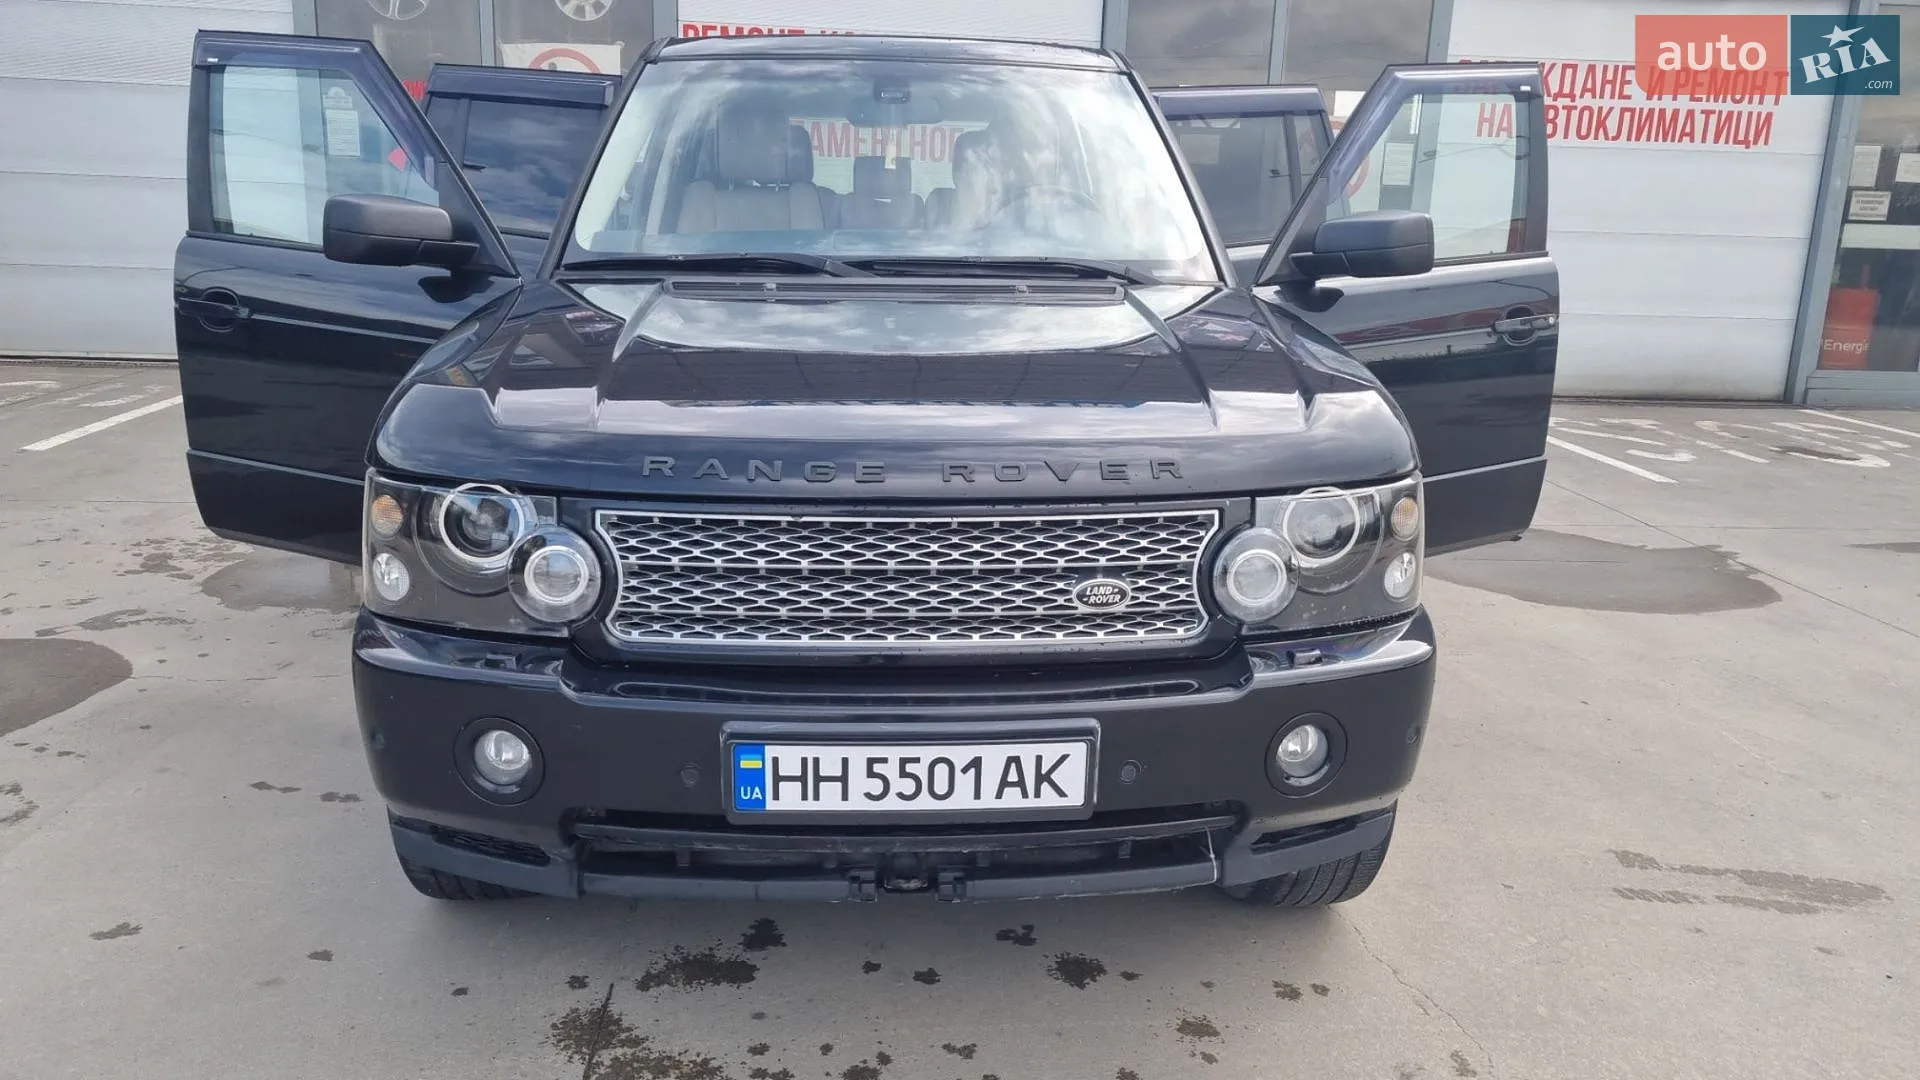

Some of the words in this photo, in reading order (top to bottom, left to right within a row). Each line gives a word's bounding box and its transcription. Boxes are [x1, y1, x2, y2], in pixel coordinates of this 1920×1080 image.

[1476, 102, 1513, 138] НА
[1544, 104, 1774, 149] ВТОКЛИМАТИЦИ
[642, 456, 887, 483] RANGE
[942, 457, 1184, 483] ROVER
[740, 786, 763, 800] UA
[863, 756, 983, 801] 5501
